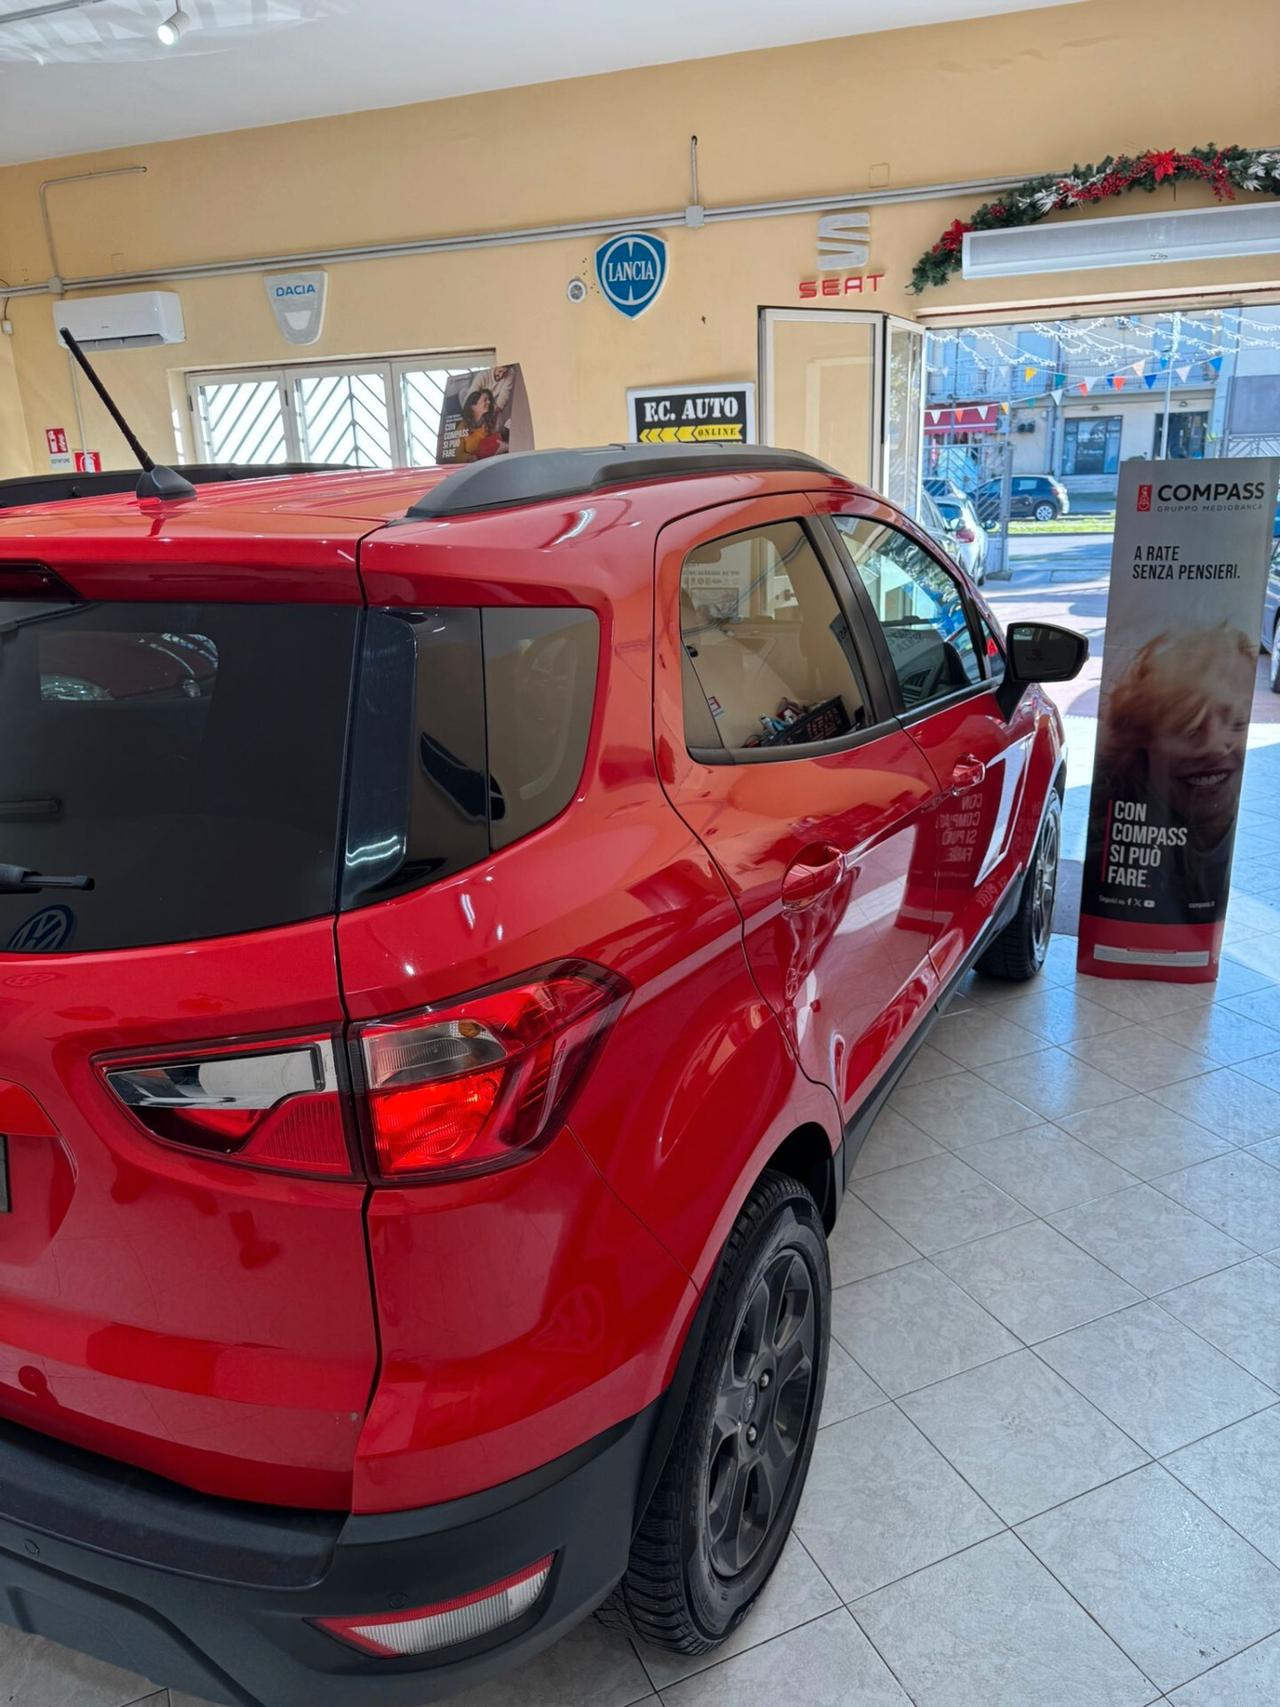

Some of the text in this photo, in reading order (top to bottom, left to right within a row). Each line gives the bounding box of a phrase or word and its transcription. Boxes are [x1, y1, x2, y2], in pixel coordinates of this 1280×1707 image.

[607, 260, 655, 282] LANCIA
[275, 283, 316, 297] DACIA
[799, 273, 885, 299] SEAT
[681, 396, 739, 419] AUTO
[697, 426, 737, 437] ONLINE
[1157, 482, 1265, 502] COMPASS
[1157, 503, 1263, 513] GRUPPO MEDIOBANCA
[1134, 545, 1181, 561] A RATE
[1132, 563, 1241, 580] SENZA PENSIERI.
[1114, 800, 1147, 822] CON
[1111, 822, 1188, 847] COMPASS
[1109, 844, 1162, 868] SI PUÒ
